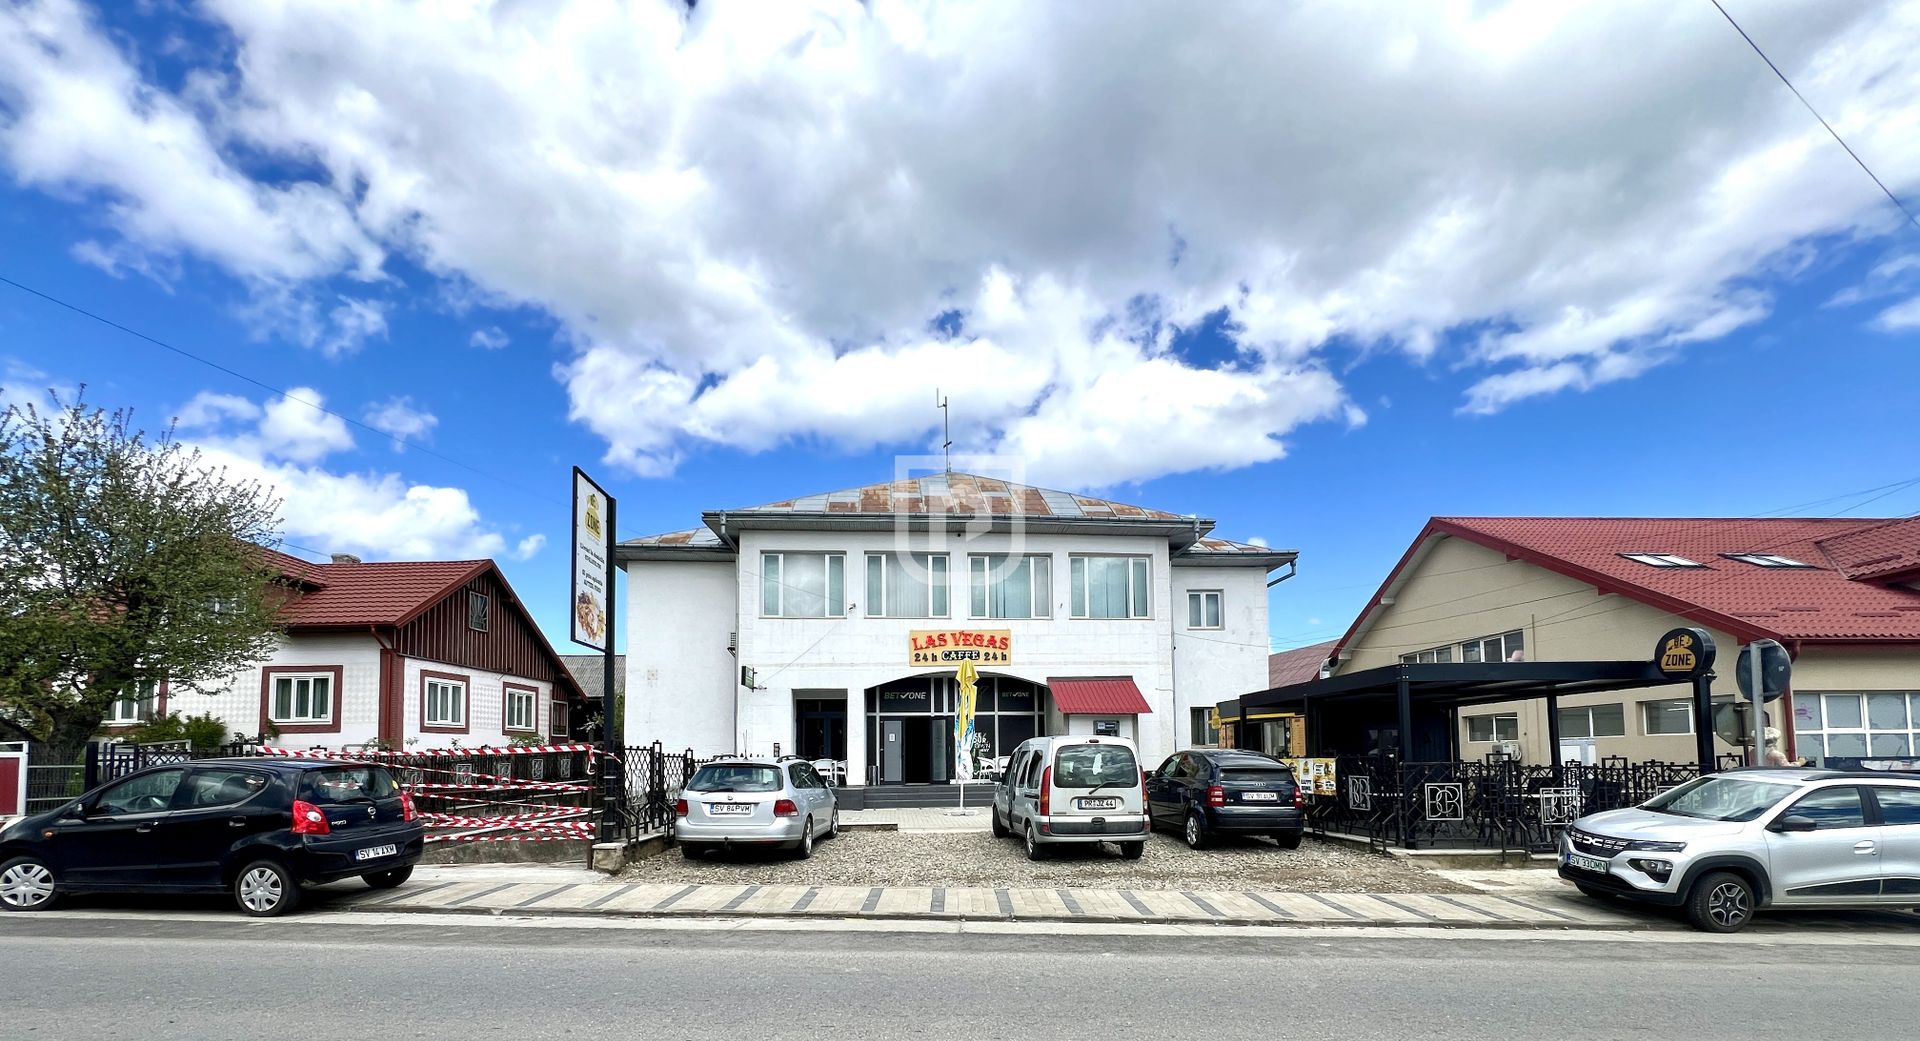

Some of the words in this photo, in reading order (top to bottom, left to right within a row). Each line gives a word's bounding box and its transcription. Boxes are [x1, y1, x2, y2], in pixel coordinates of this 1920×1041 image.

[911, 633, 947, 650] LAS
[951, 631, 1009, 650] VEGAS
[942, 651, 979, 660] CAFFE
[1665, 653, 1692, 667] ZONE
[715, 804, 724, 812] SV
[360, 850, 370, 859] SV
